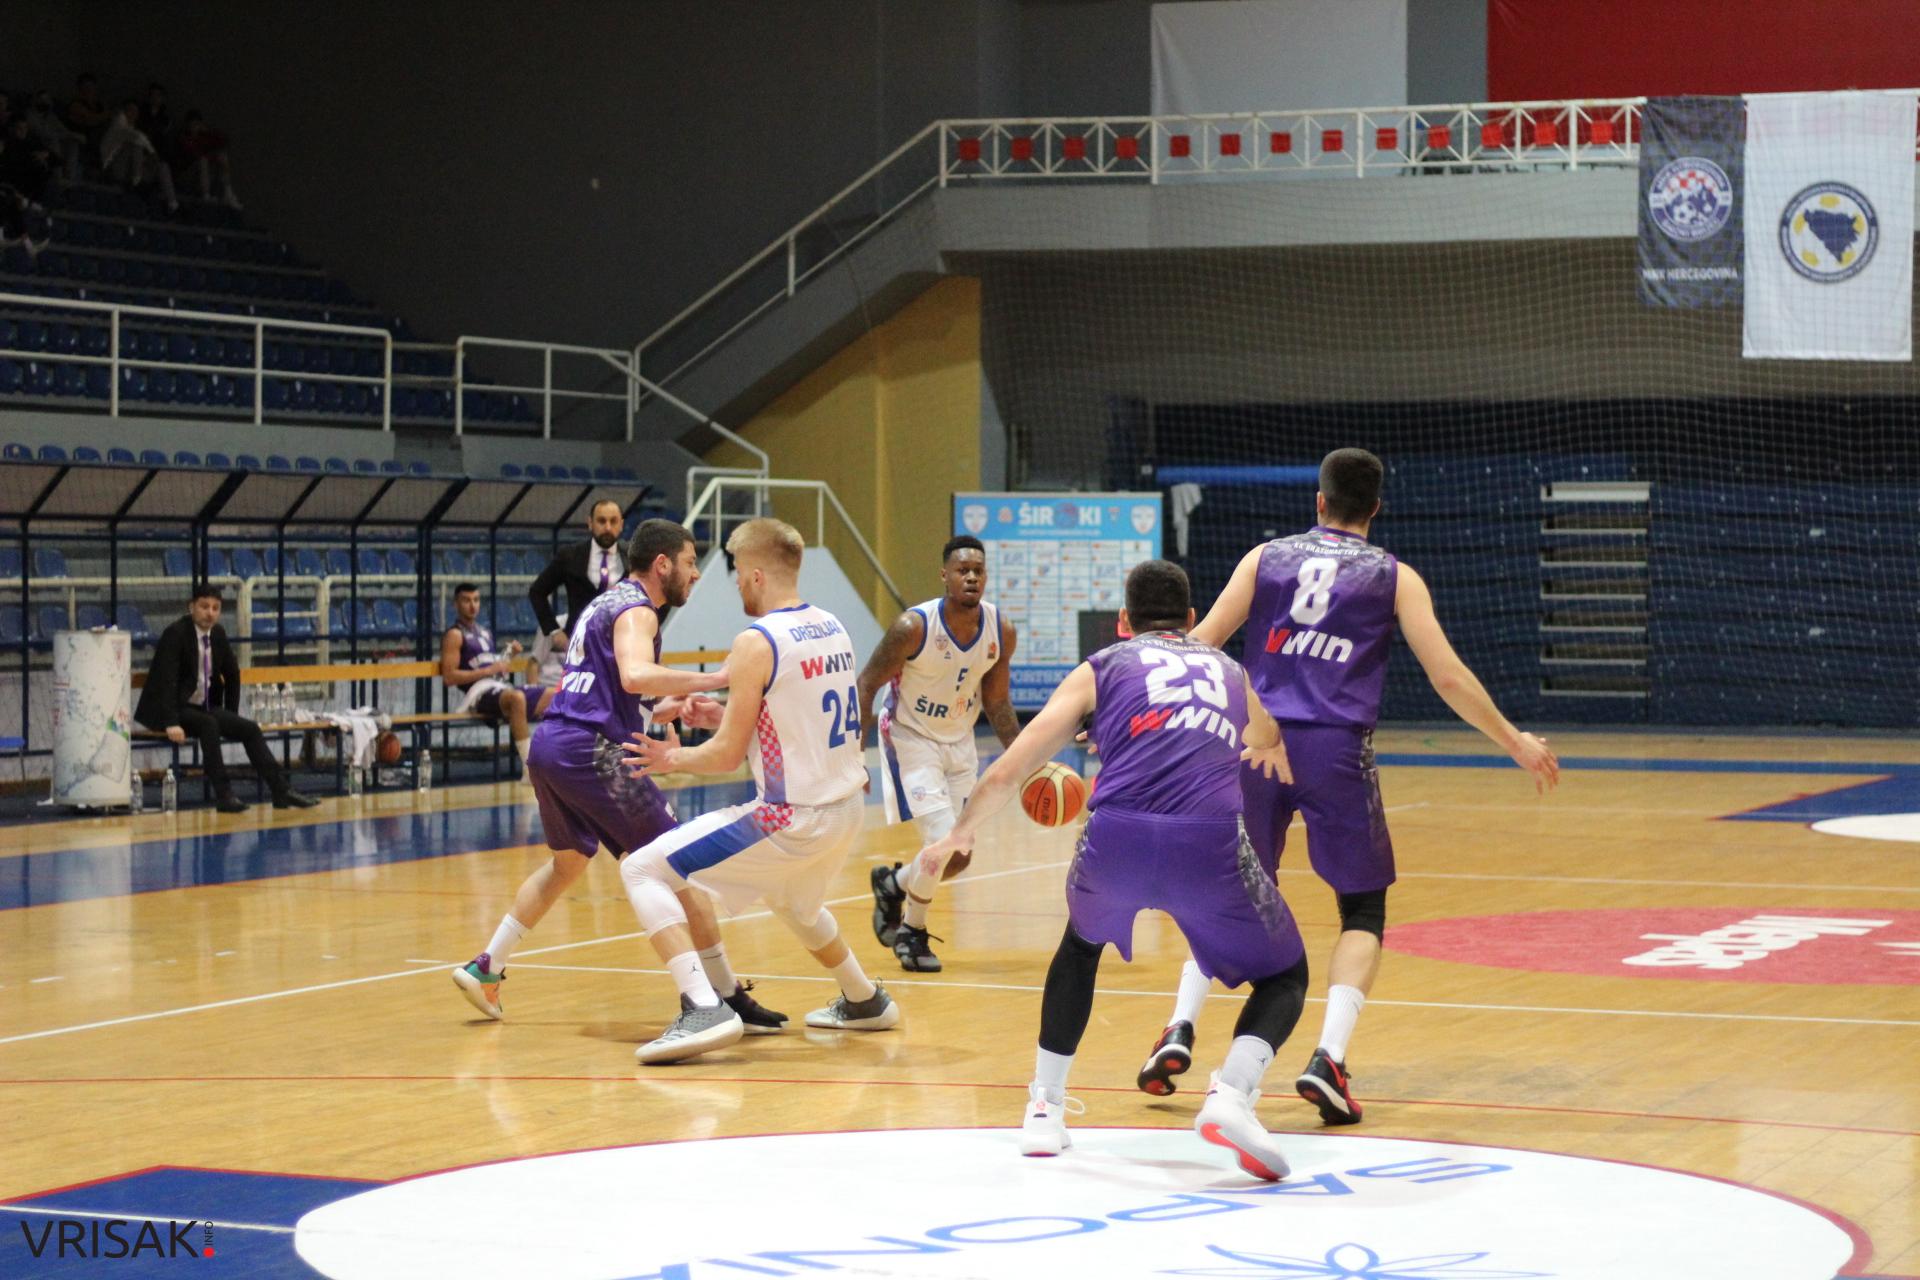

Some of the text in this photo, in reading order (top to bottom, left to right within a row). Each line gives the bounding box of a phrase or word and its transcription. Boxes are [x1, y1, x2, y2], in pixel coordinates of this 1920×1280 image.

[1289, 557, 1339, 626] 8
[1139, 647, 1229, 710] 23
[822, 685, 862, 749] 24
